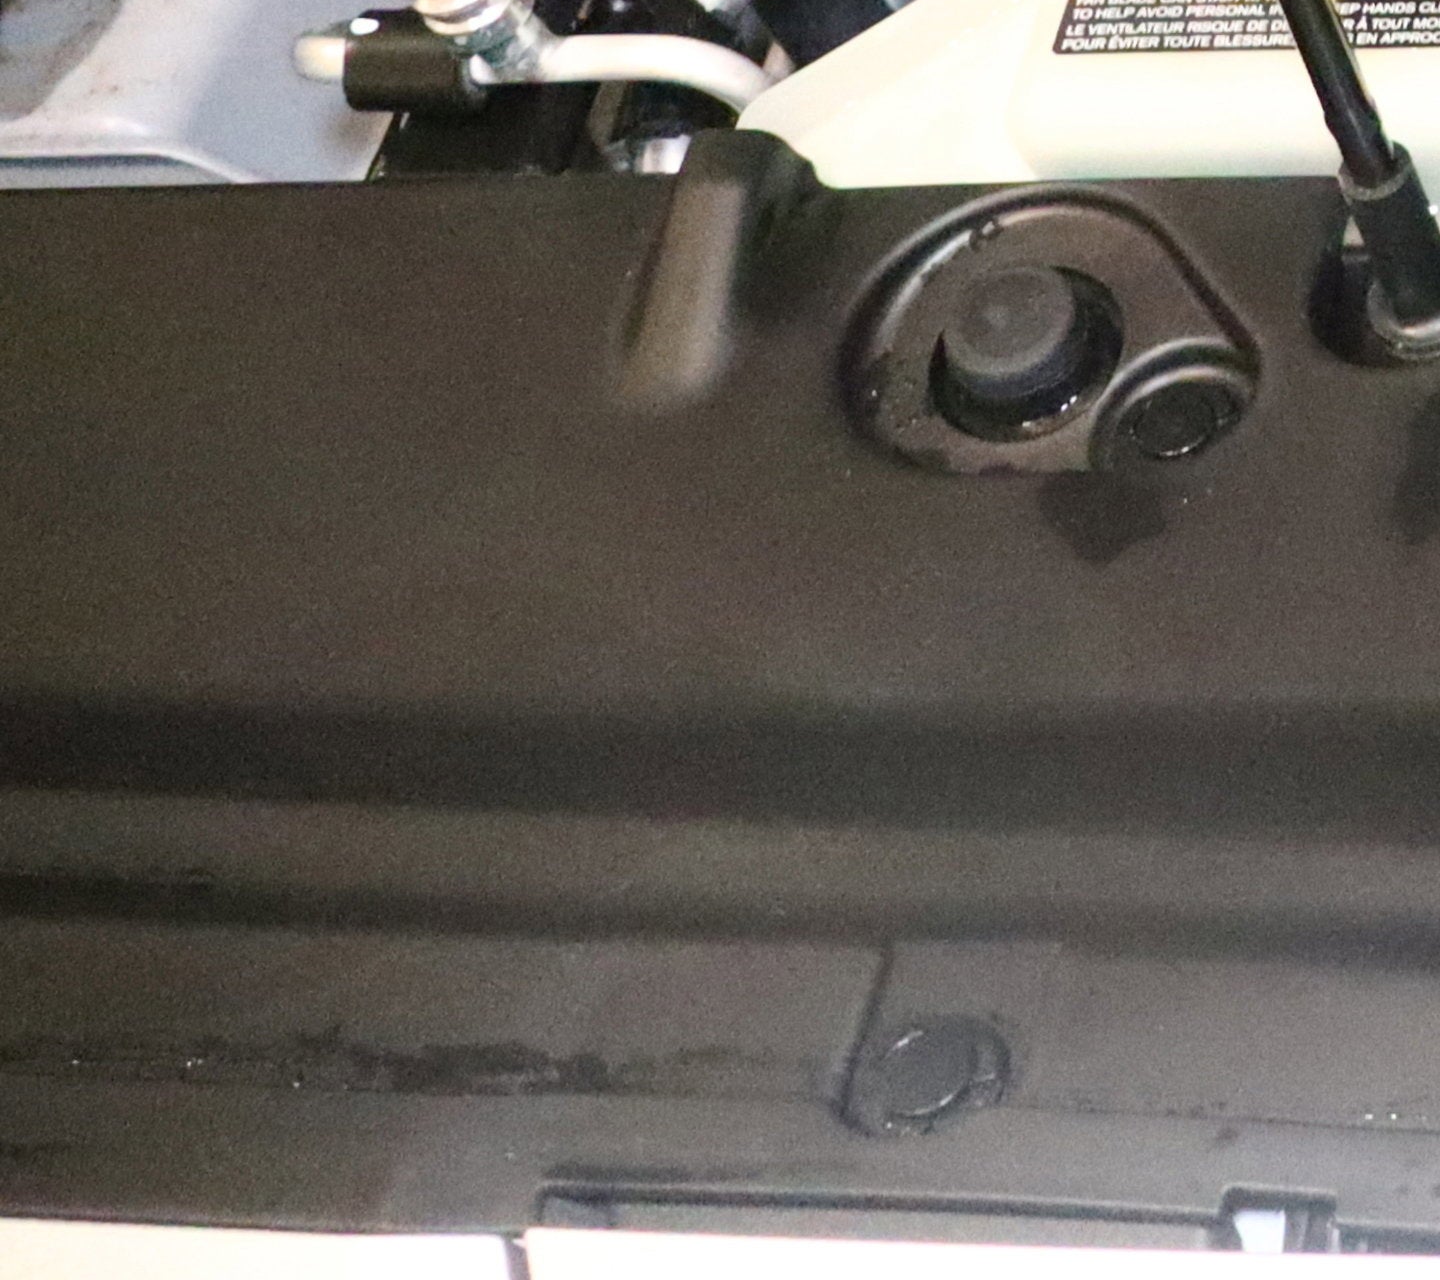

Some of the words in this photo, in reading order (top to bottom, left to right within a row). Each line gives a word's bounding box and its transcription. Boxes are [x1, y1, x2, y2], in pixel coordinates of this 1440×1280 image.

[1073, 8, 1093, 20] TO
[1095, 6, 1136, 19] HELP
[1136, 5, 1183, 18] AVOID
[1185, 3, 1266, 17] PERSONAL
[1362, 1, 1416, 15] HANDS
[1065, 23, 1085, 37] LE
[1088, 21, 1185, 36] VENTILATEUR
[1187, 20, 1244, 34] RISQUE
[1246, 19, 1269, 32] DE
[1371, 17, 1411, 30] TOUT
[1061, 37, 1106, 51] POUR
[1107, 34, 1160, 49] ÉVITER
[1163, 35, 1212, 49] TOUTE
[1357, 32, 1378, 44] EN
